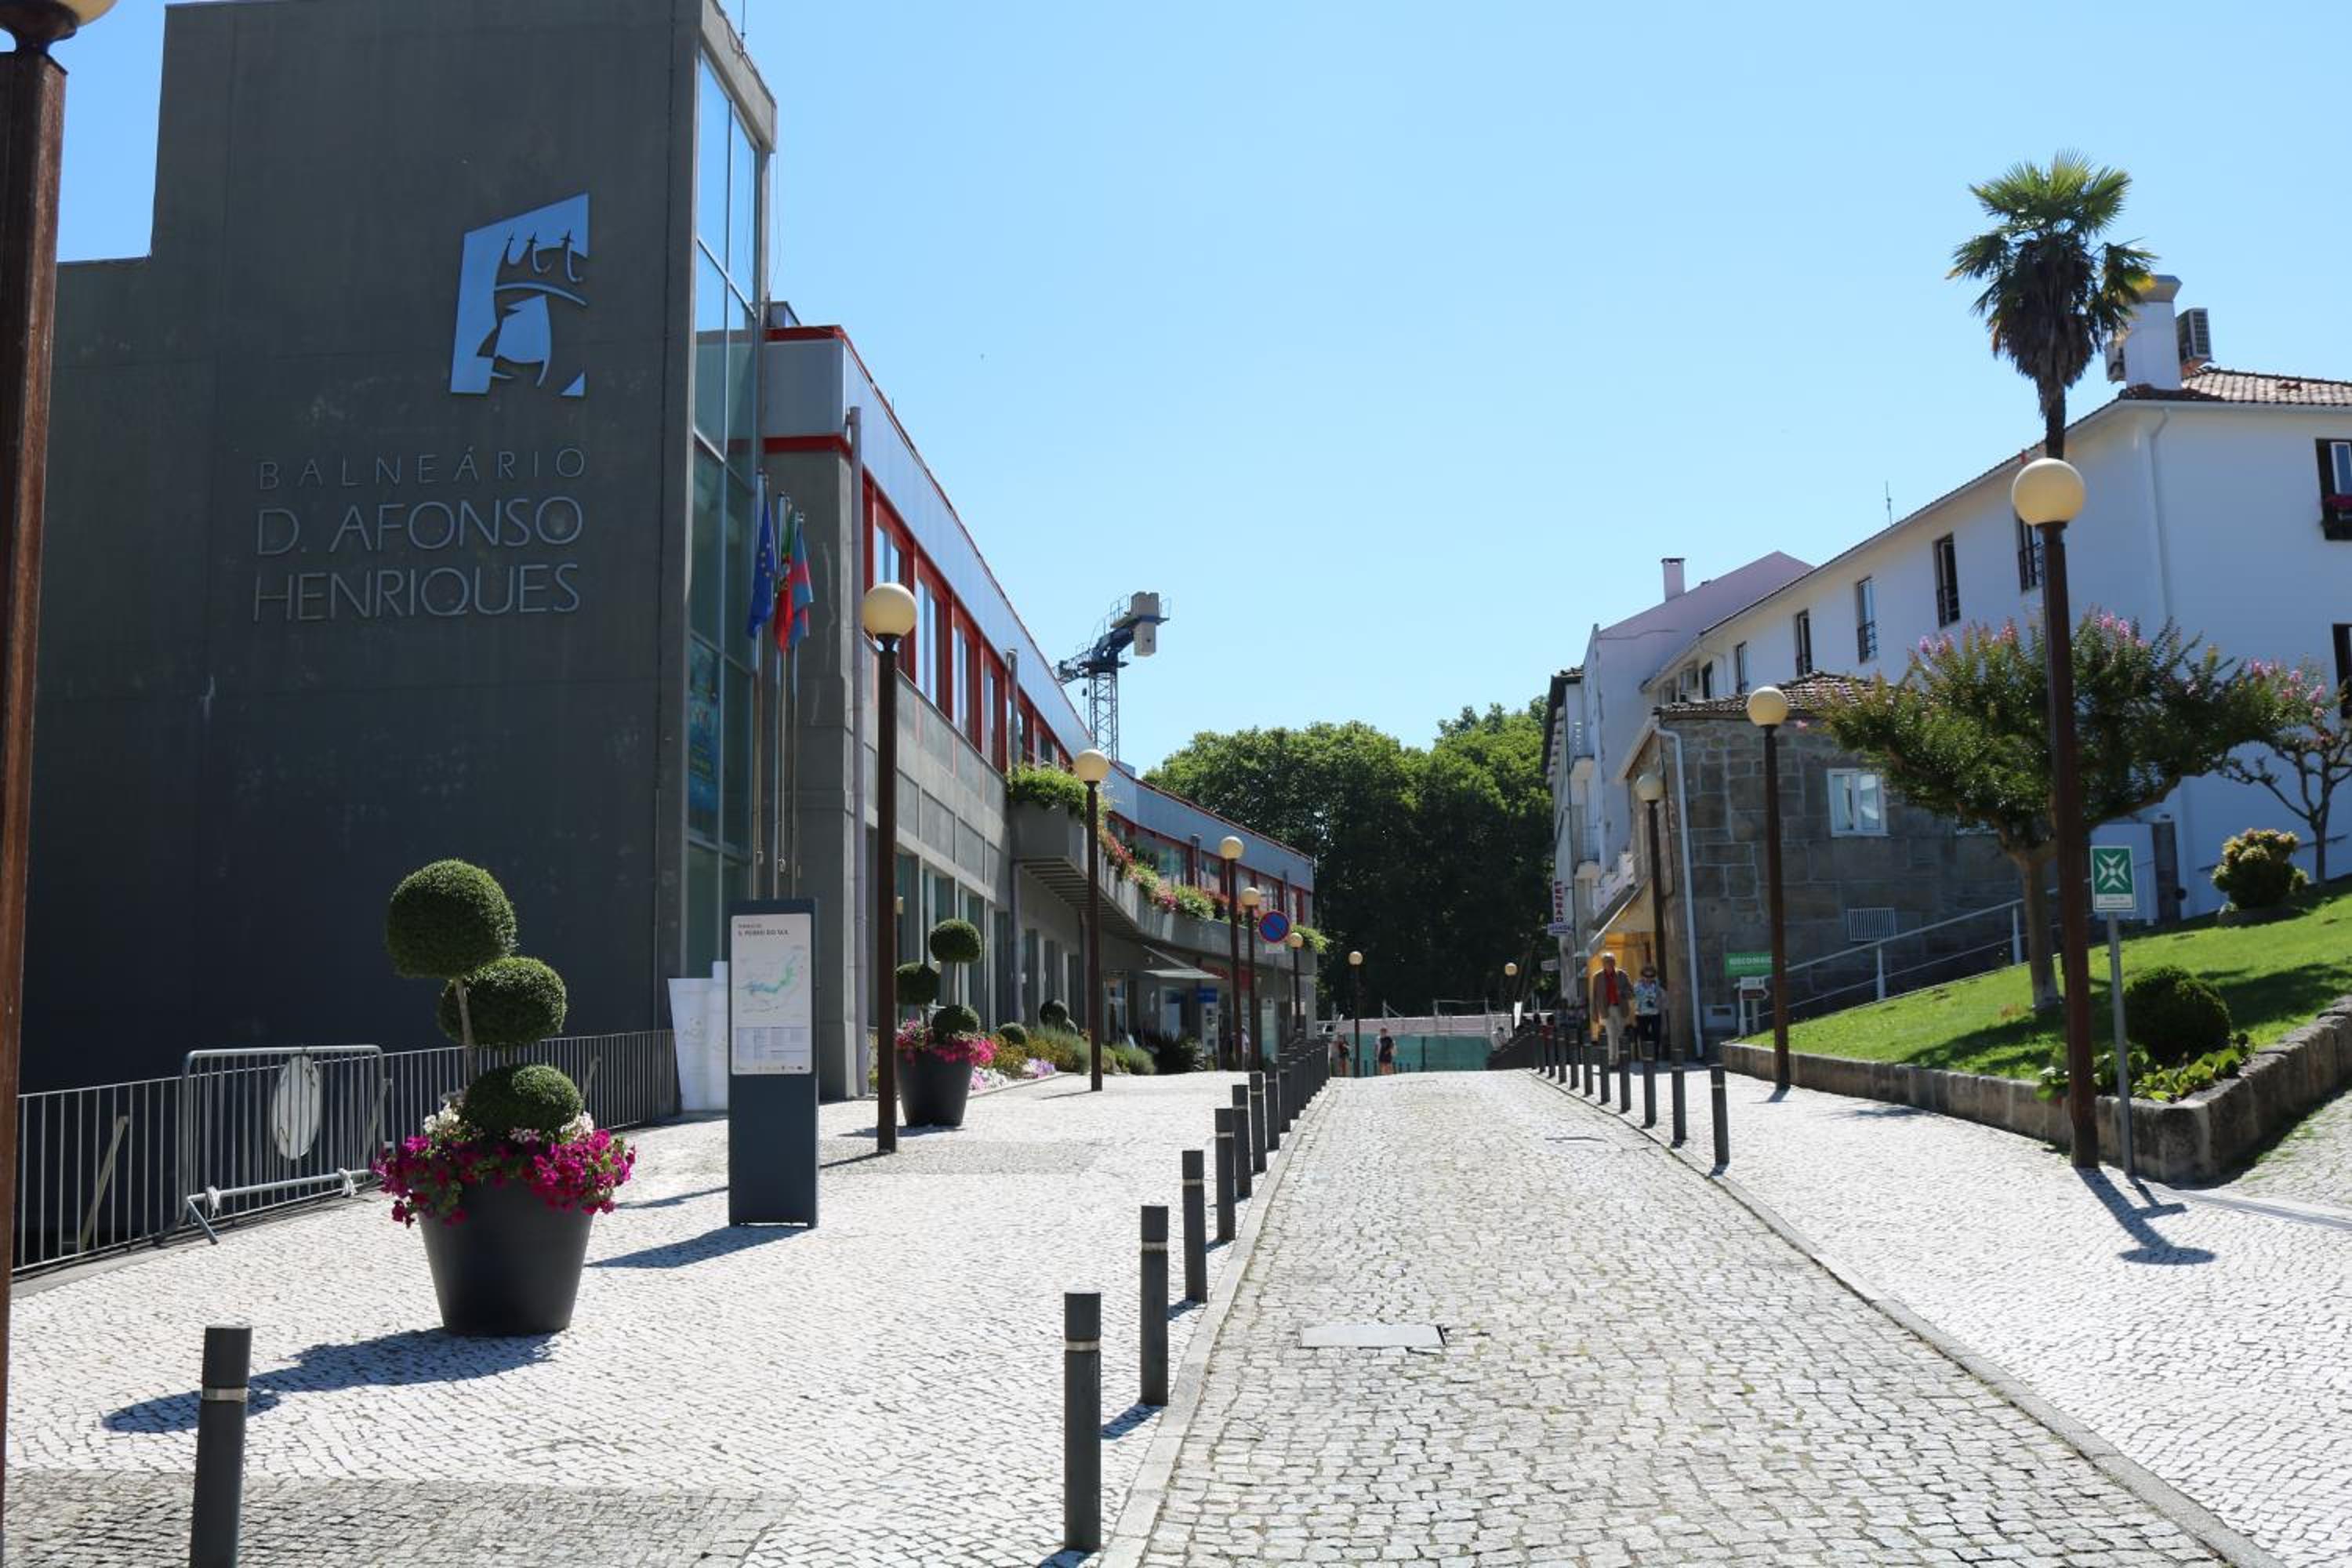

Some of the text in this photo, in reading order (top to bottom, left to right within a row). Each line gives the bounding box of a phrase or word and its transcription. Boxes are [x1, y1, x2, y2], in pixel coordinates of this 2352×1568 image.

[259, 445, 585, 491] BALNEÁRIO
[257, 495, 583, 556] D. AFONSO
[253, 562, 581, 622] HENRIQUES
